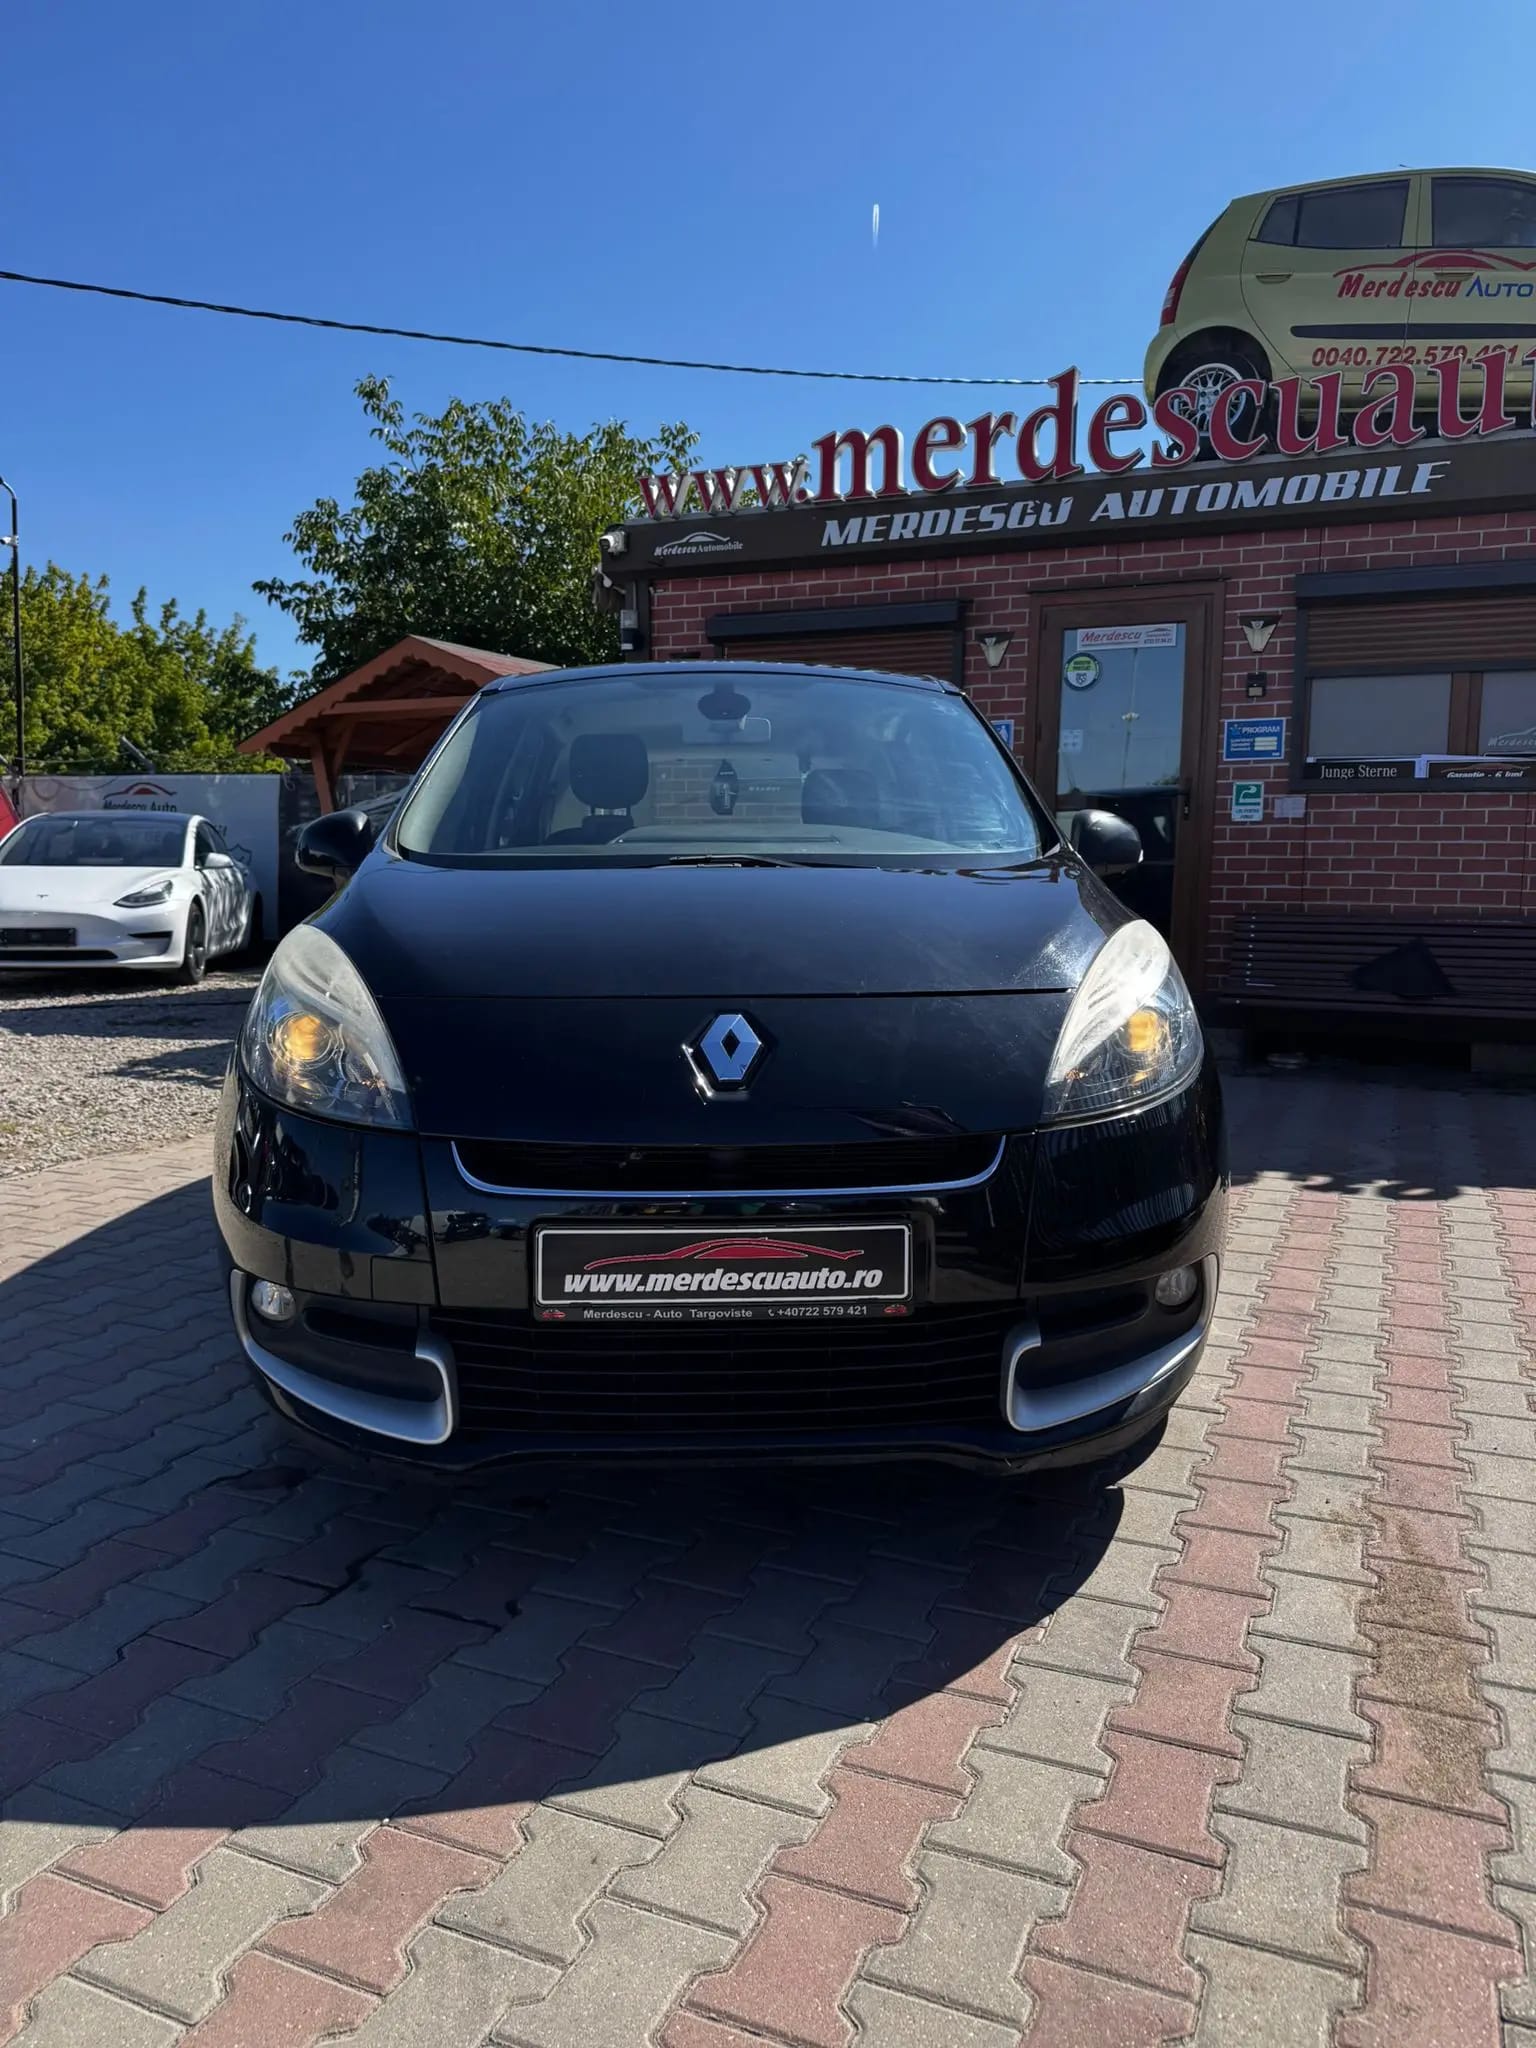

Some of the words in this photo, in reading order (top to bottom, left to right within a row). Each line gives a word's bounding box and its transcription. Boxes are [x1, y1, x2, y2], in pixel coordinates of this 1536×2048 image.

[1337, 272, 1462, 298] Merdescu
[1465, 275, 1534, 298] AUTO
[821, 496, 1074, 547] MERDESCU
[1089, 460, 1452, 523] AUTOMOBILE
[654, 545, 697, 556] Merdescu
[1081, 630, 1142, 642] Merdescu
[1242, 725, 1280, 734] PROGRAM
[1320, 765, 1355, 780] Junge
[1358, 764, 1397, 778] Sterne
[563, 1268, 883, 1293] www.merdescuauto.ro
[583, 1309, 643, 1319] Merdescu
[653, 1309, 683, 1319] Auto
[689, 1308, 753, 1320] Targoviste
[776, 1306, 820, 1317] +40722
[823, 1306, 844, 1316] 579
[847, 1305, 868, 1315] 421
